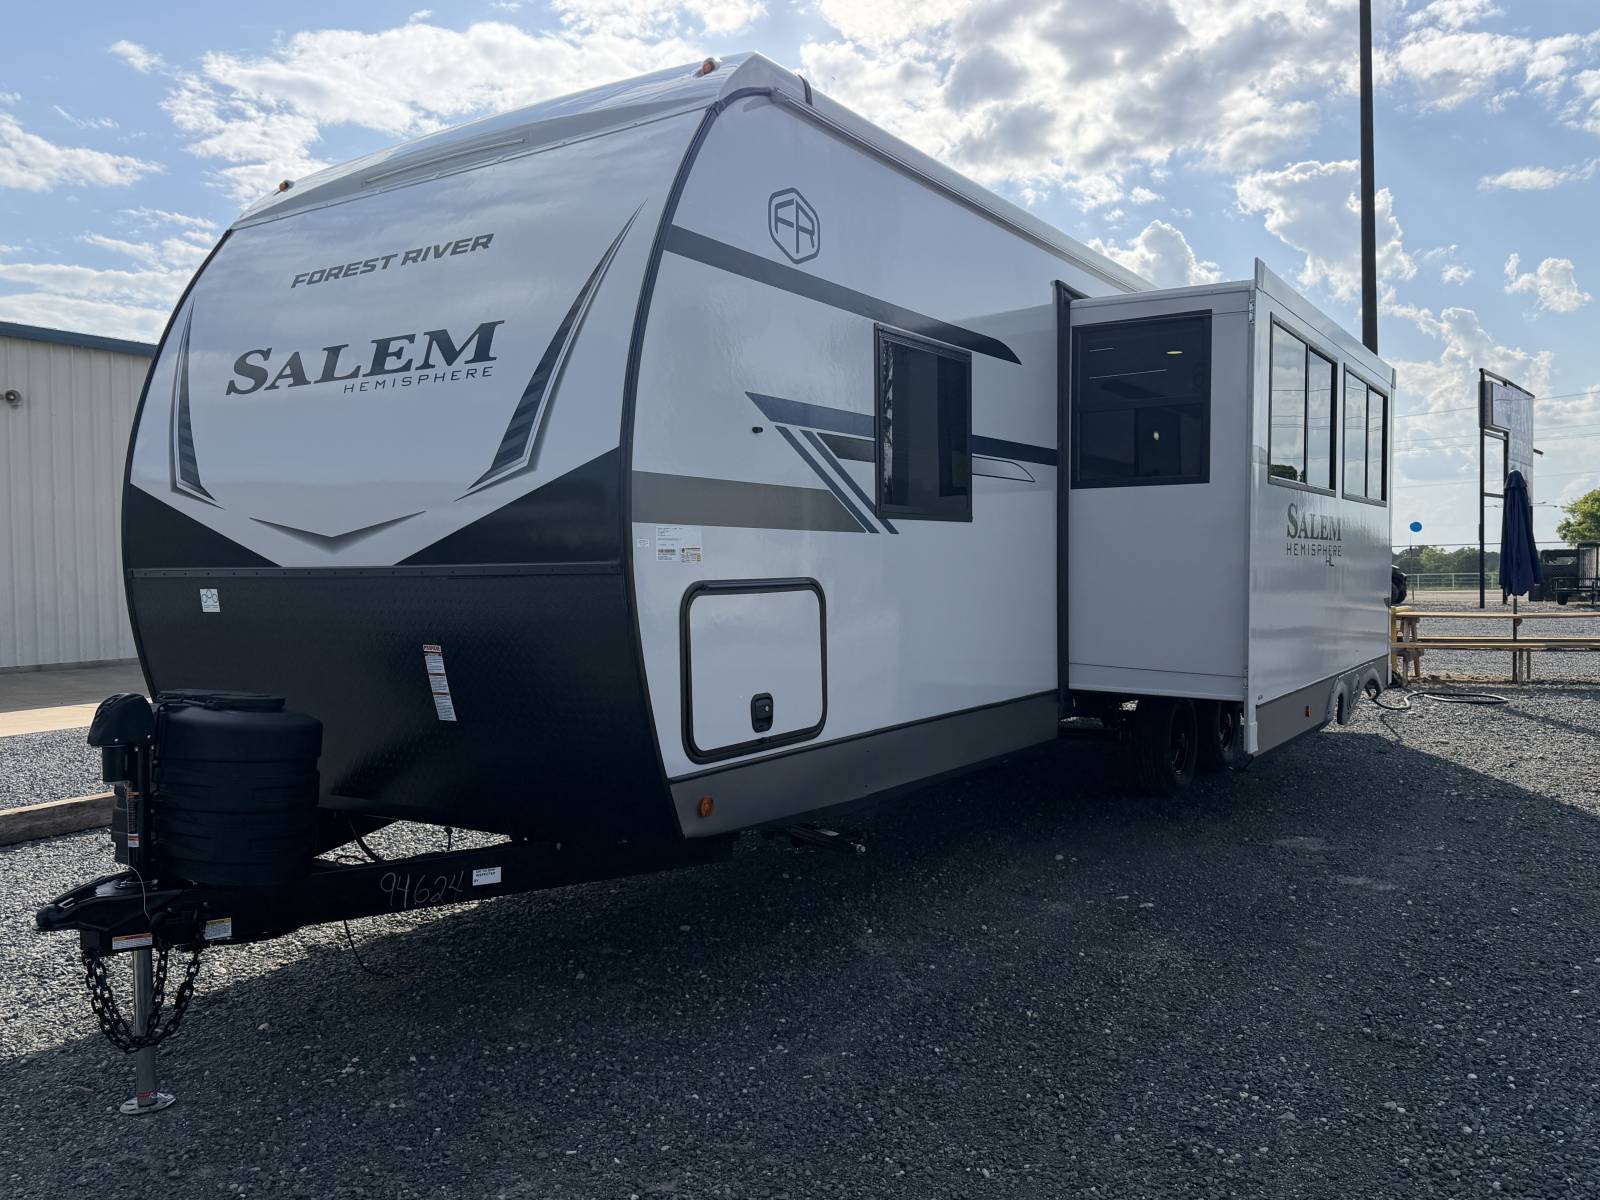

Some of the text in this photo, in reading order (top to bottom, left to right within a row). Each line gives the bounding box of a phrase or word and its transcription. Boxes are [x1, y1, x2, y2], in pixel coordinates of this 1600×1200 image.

[291, 233, 494, 288] FOREST RIVER
[225, 320, 505, 395] SALEM
[343, 366, 494, 394] HEMISPHERE
[1287, 503, 1342, 541] SALEM
[1286, 543, 1342, 557] HEMISPHERE
[380, 870, 464, 908] 94624
